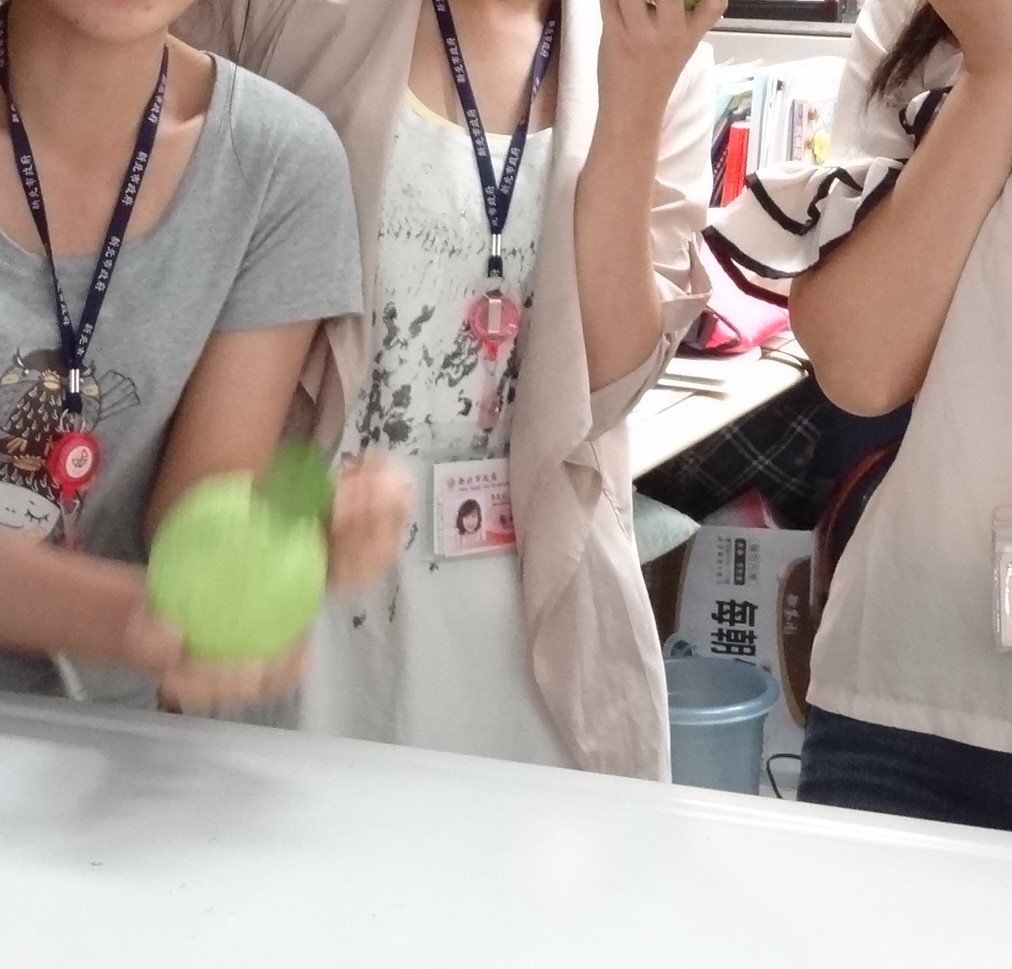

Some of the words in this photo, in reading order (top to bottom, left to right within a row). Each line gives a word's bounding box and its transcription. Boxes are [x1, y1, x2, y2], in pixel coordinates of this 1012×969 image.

[121, 150, 148, 206] 新北市政府
[95, 235, 121, 292] 新北市政府
[710, 599, 759, 666] 每朝
